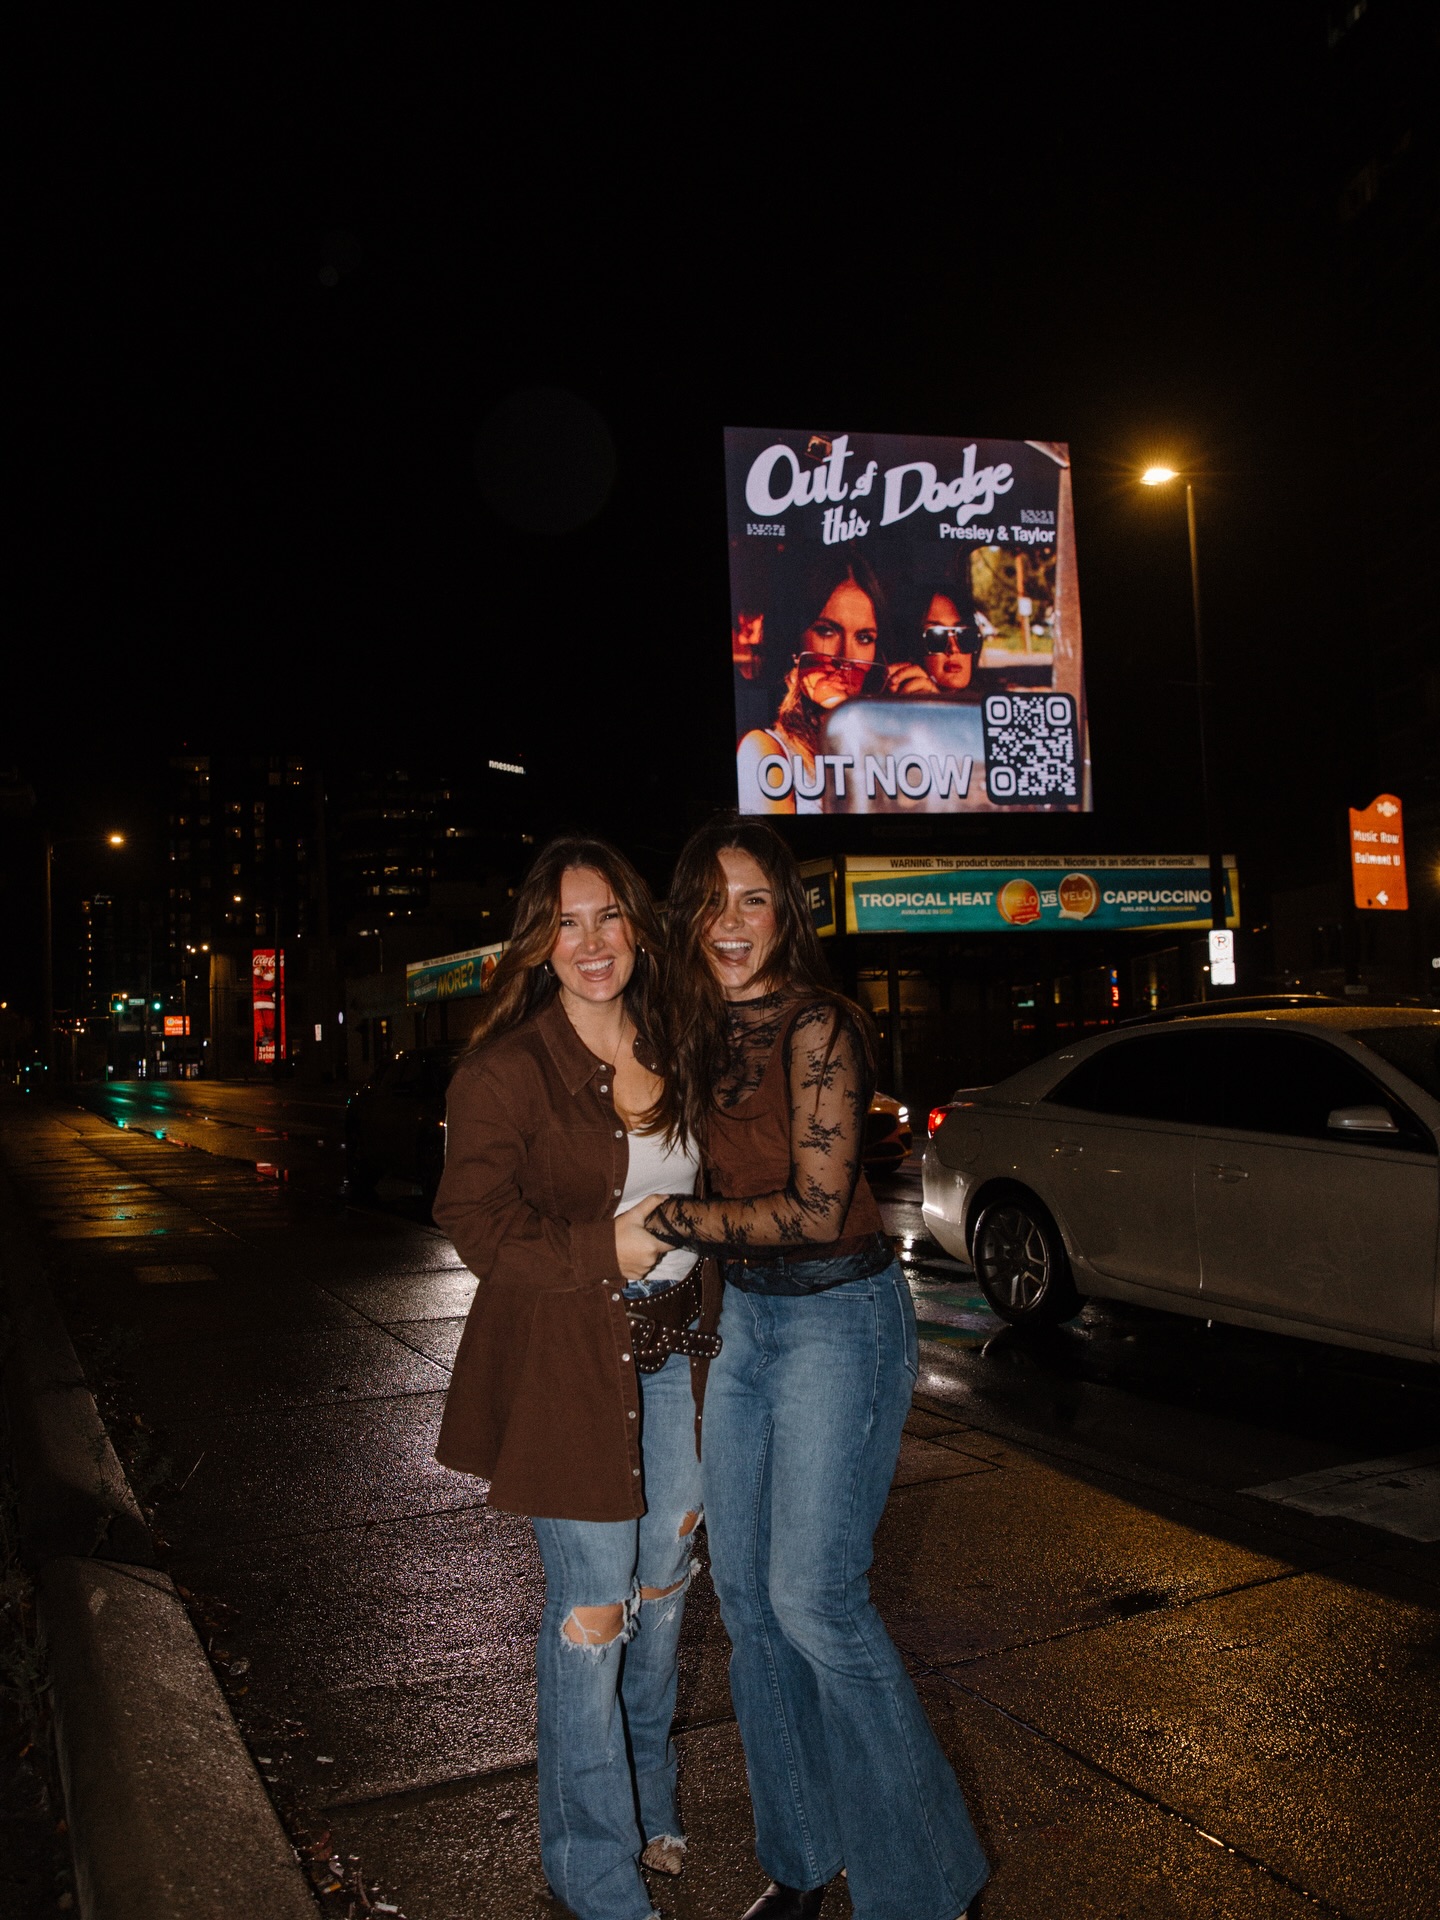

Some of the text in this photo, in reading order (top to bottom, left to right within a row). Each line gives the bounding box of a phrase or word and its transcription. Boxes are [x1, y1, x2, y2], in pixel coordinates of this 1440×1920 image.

[745, 434, 1015, 526] Out of Dodge
[821, 505, 870, 545] this
[939, 522, 1056, 545] Presley & Taylor
[757, 754, 973, 801] OUT NOW
[1353, 830, 1400, 844] Music Row
[890, 859, 934, 868] WARNING:
[936, 859, 953, 867] This
[956, 859, 988, 868] product
[990, 858, 1025, 867] contains
[1027, 858, 1062, 867] nicotine.
[1064, 858, 1097, 866] Nicotine
[1099, 858, 1106, 866] is
[1120, 857, 1156, 866] addictive
[1158, 857, 1195, 866] chemical.
[859, 891, 993, 907] TROPICAL HEAT
[1041, 893, 1057, 904] VS
[1103, 890, 1212, 904] CAPPUCCINO
[437, 961, 475, 998] MORE?
